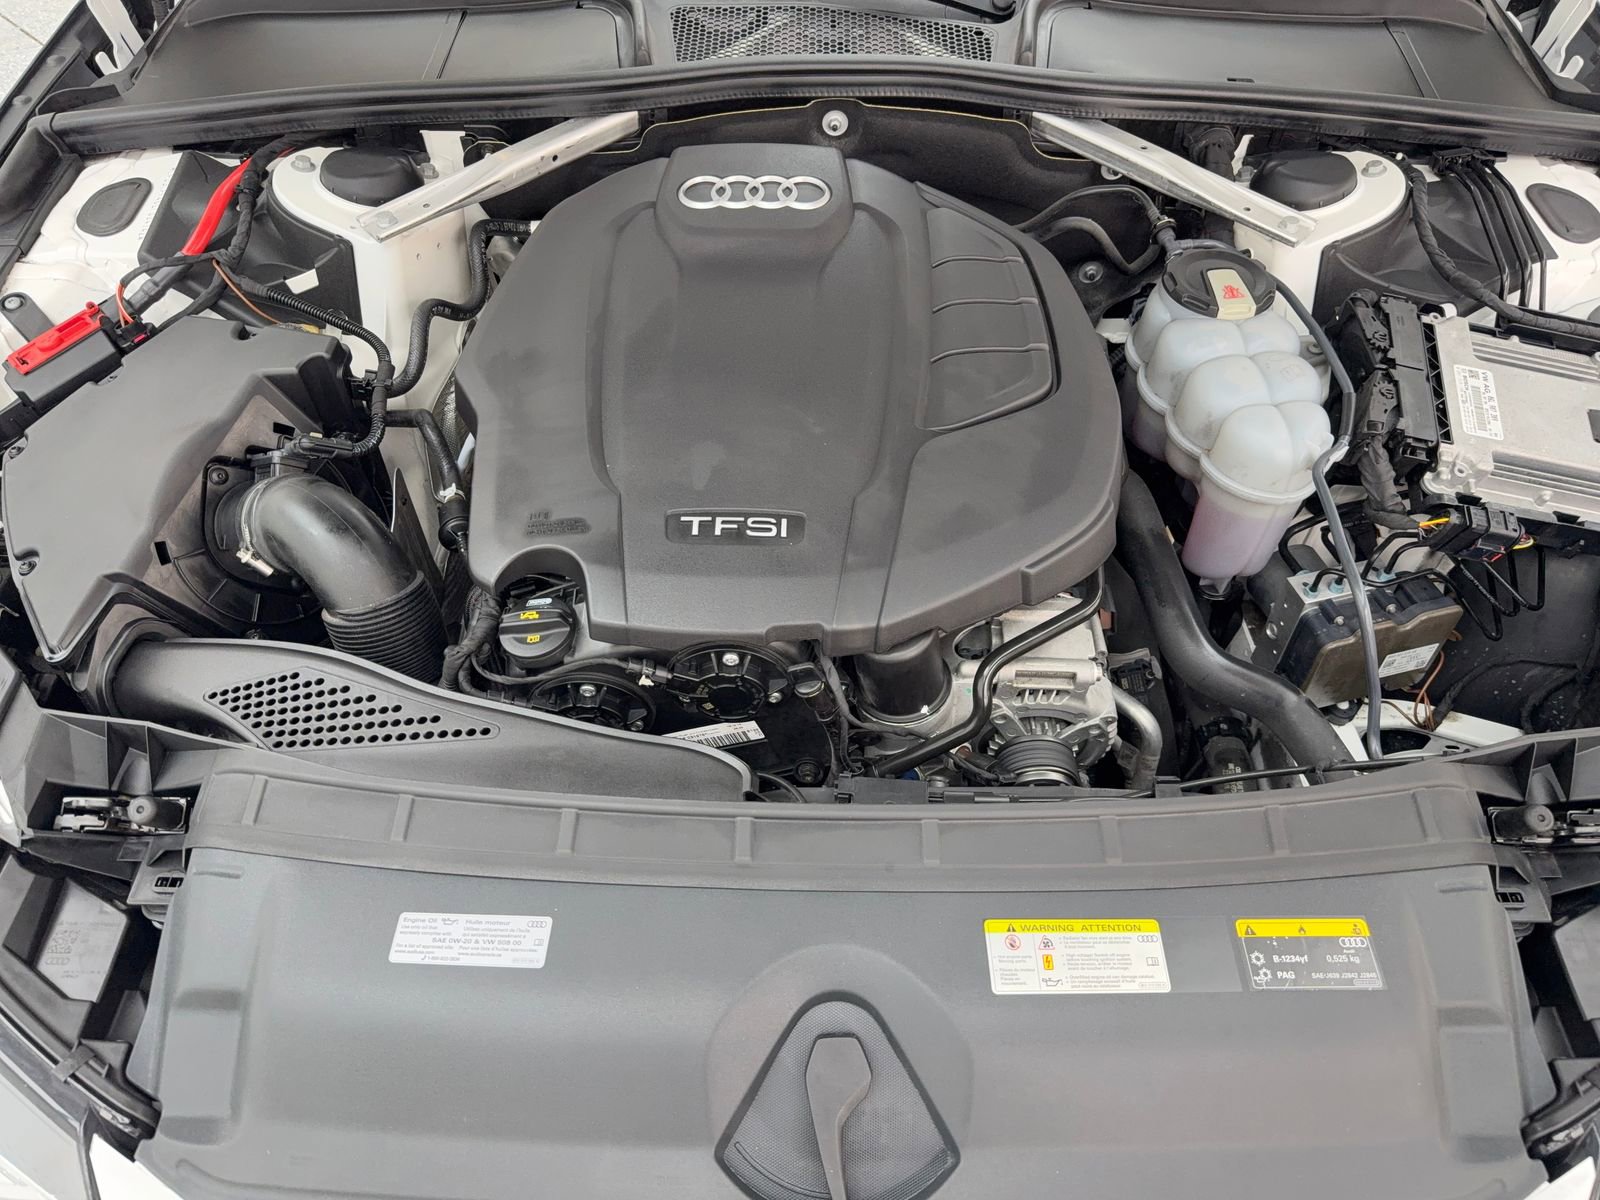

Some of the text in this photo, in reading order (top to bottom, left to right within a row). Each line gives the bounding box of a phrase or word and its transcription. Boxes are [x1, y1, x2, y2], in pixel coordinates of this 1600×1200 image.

[680, 516, 788, 538] TFSI
[1019, 923, 1142, 932] WARNING ATTENTION
[1326, 954, 1348, 963] 0,525
[1348, 954, 1360, 964] kg
[1276, 970, 1296, 980] PAG
